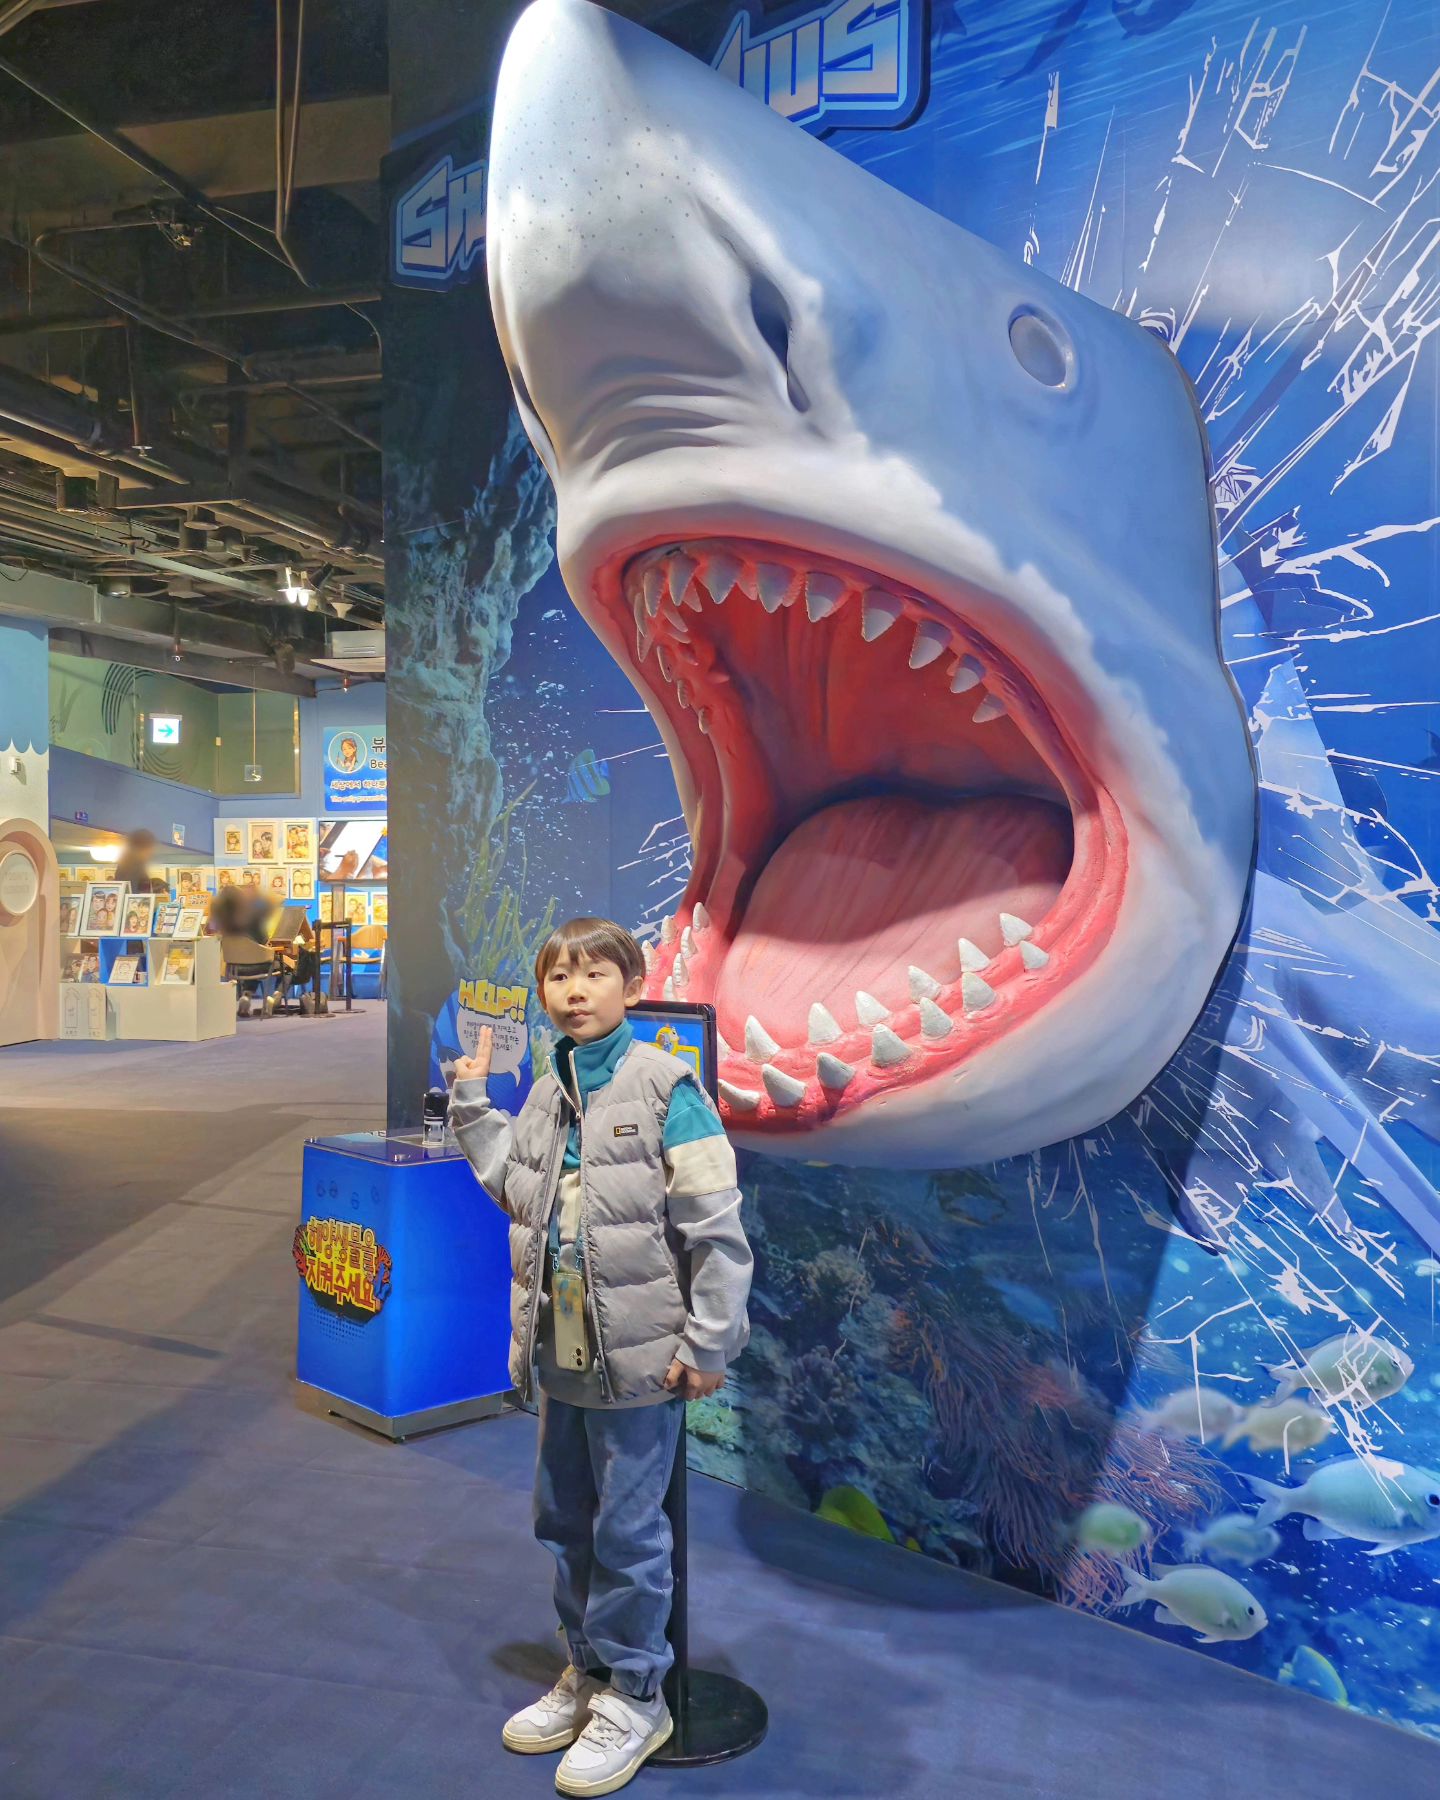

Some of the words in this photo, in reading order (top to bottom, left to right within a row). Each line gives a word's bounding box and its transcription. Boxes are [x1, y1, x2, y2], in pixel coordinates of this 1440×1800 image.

[459, 979, 528, 1023] HELP!!
[306, 1216, 376, 1282] 해양생물을
[306, 1255, 376, 1312] 지켜주세요
